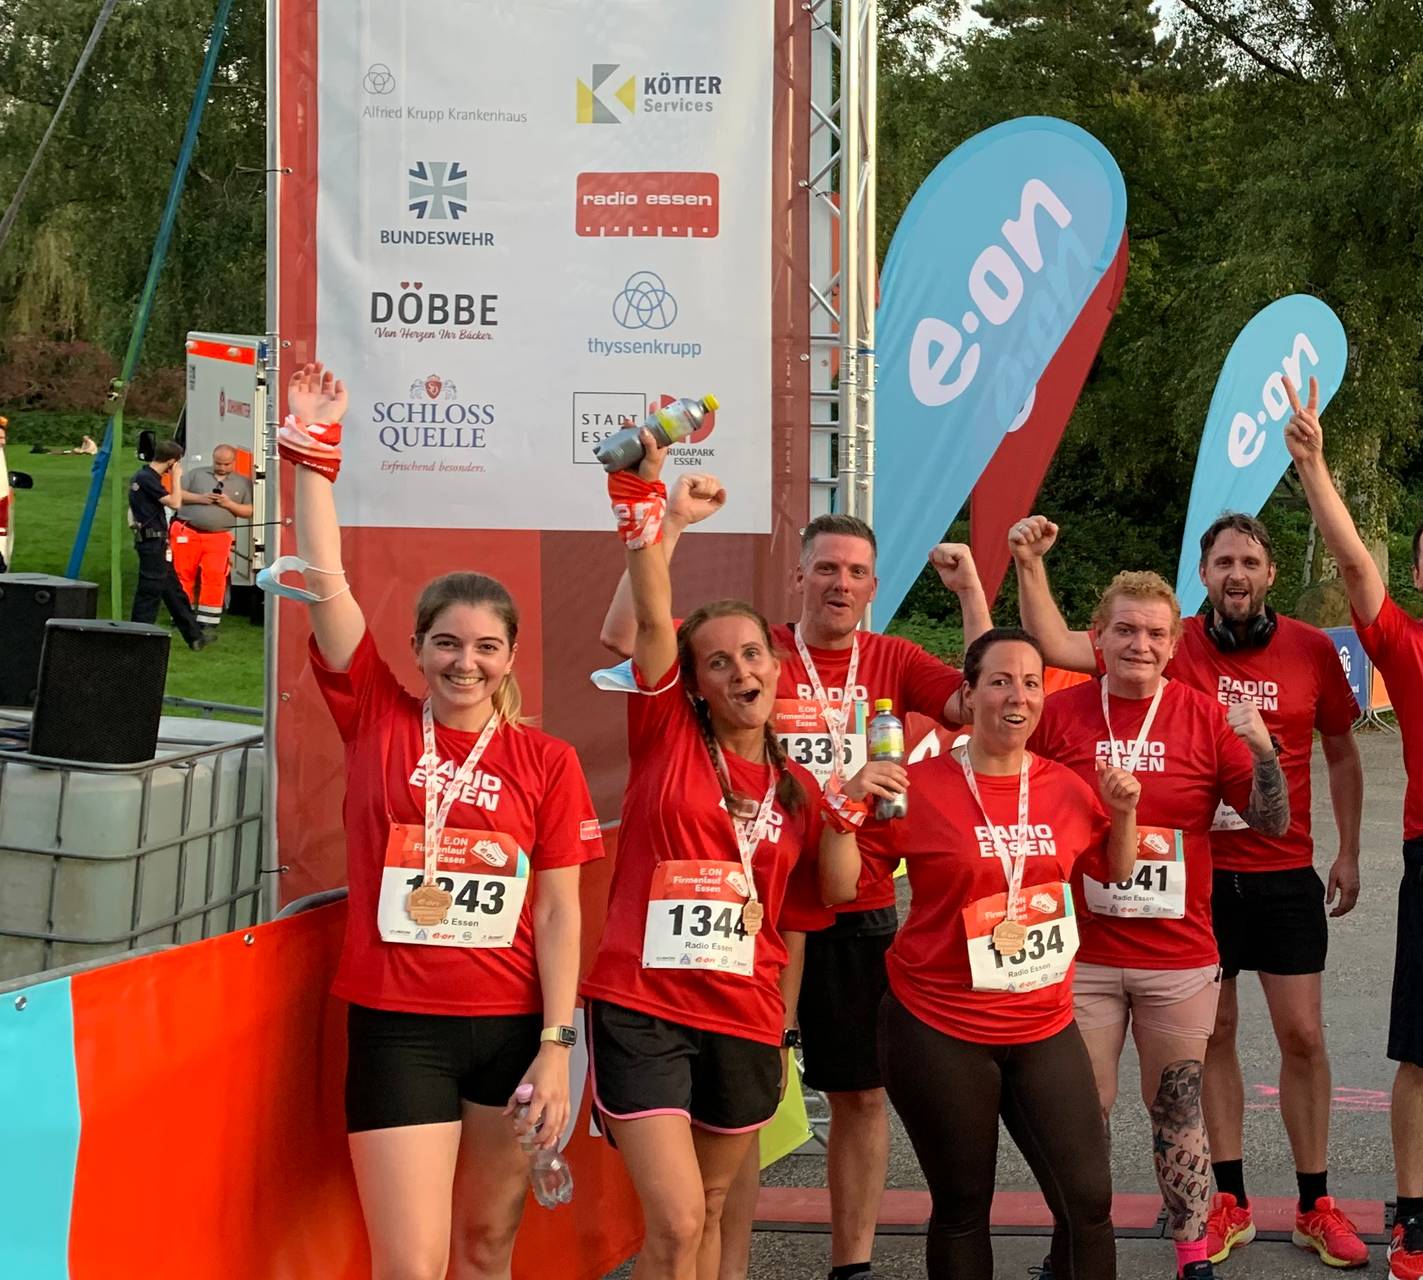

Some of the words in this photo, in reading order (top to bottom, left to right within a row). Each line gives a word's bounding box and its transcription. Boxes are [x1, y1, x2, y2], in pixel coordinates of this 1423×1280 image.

[644, 72, 722, 95] KÖTTER
[644, 98, 714, 113] Services
[362, 105, 402, 119] Alfried
[407, 106, 445, 123] Krupp
[448, 107, 528, 123] Krankenhaus
[582, 191, 638, 206] radio
[645, 194, 713, 207] essen
[380, 229, 495, 247] BUNDESWEHR
[370, 281, 499, 326] DÖBBE
[375, 327, 397, 339] Von
[399, 328, 436, 343] Herzen
[438, 328, 457, 340] Ihr
[588, 338, 702, 358] thyssenkrupp
[372, 402, 495, 425] SCHLOSS
[581, 413, 638, 426] STADT
[379, 425, 487, 453] QUELLE
[666, 447, 716, 457] RUGAPARK
[380, 460, 435, 474] Erfrischend
[438, 461, 487, 474] besonders.
[674, 457, 702, 466] ESSEN
[797, 683, 869, 701] RDO
[1217, 675, 1279, 697] RADIO
[1095, 740, 1166, 757] RADIO
[408, 767, 500, 812] EEN
[412, 842, 468, 856] Fienlauf
[444, 836, 469, 847] E.ON
[436, 855, 467, 865] Essen
[672, 875, 722, 884] Firmenlauf
[694, 884, 721, 893] Essen
[1113, 894, 1132, 902] Radio
[451, 917, 480, 928] Essen
[668, 904, 748, 942] 1344
[684, 941, 710, 950] Radio
[711, 942, 733, 952] Essen
[1008, 969, 1029, 979] Radio
[1030, 963, 1051, 974] Essen
